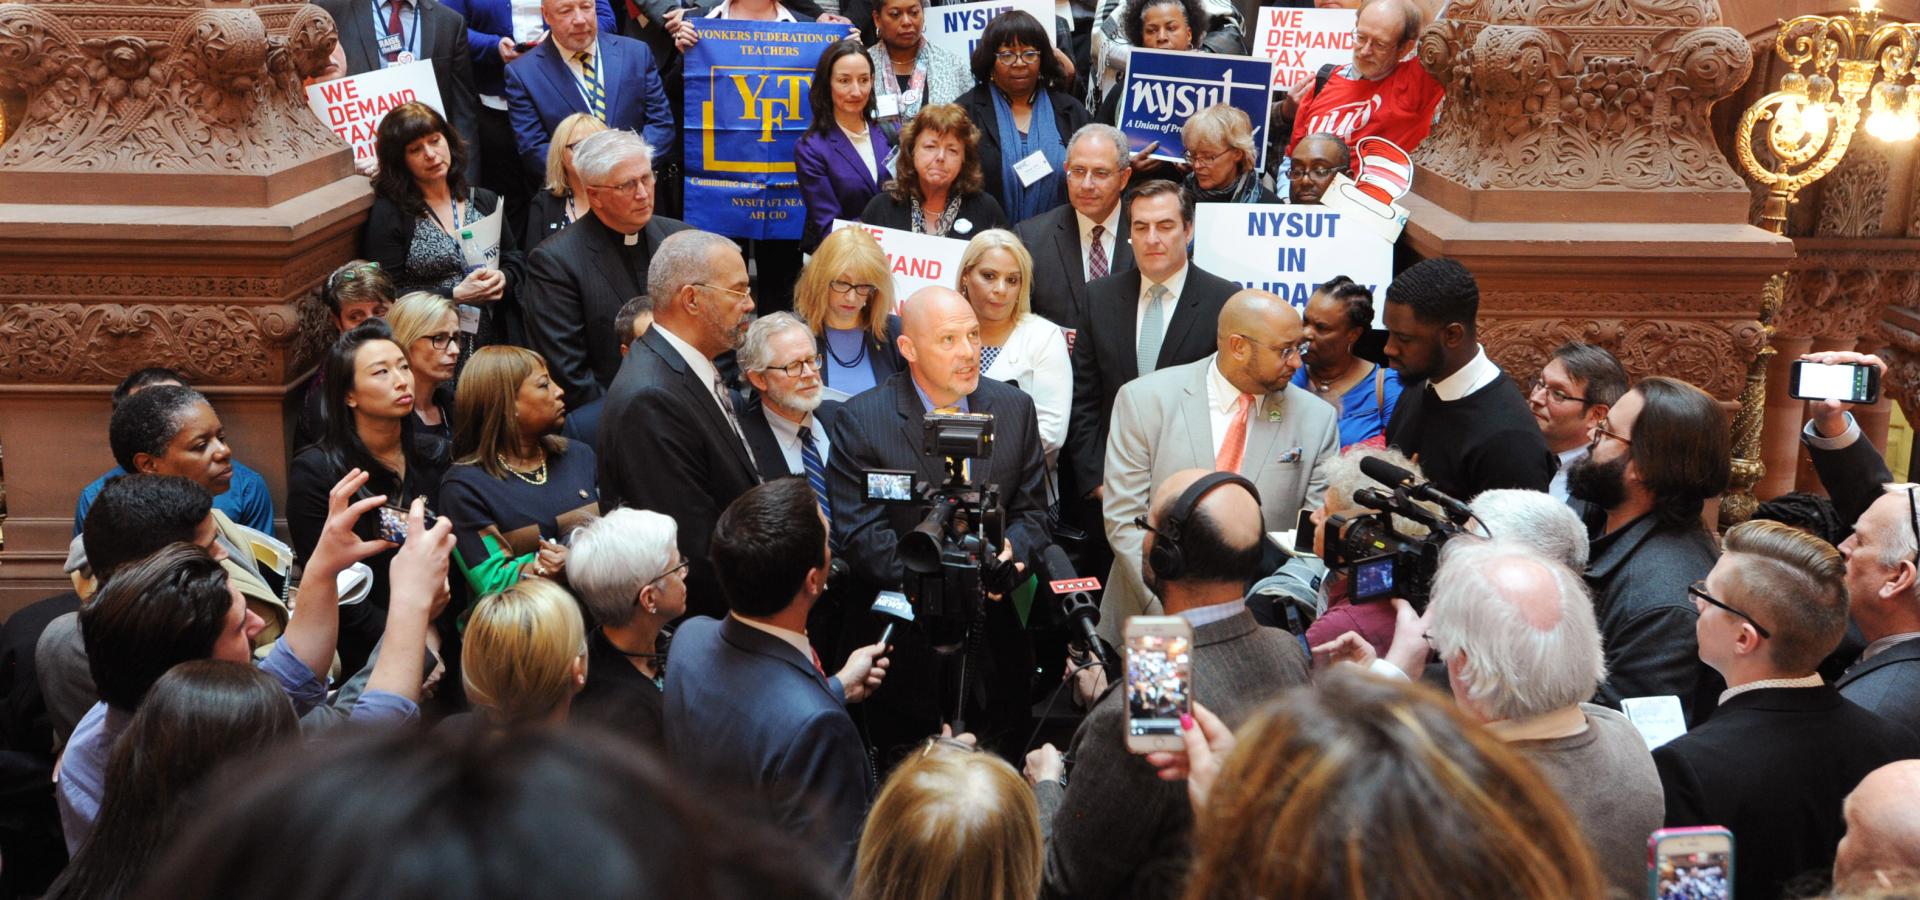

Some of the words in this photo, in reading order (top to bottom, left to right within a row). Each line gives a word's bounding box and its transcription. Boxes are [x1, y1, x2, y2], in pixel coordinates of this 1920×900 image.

[1271, 10, 1303, 28] WE
[698, 29, 750, 41] YONKERS
[754, 31, 823, 43] FEDERATION
[1267, 29, 1353, 50] DEMAND
[740, 45, 800, 56] TEACHERS
[1265, 49, 1306, 67] TAX
[320, 80, 359, 104] WE
[328, 89, 417, 126] DEMAND
[334, 120, 378, 144] TAX
[1135, 121, 1159, 131] Union
[1161, 124, 1172, 135] of
[732, 198, 765, 208] NYSUT
[785, 198, 803, 207] NEA
[769, 211, 787, 220] CIO
[1248, 212, 1340, 238] NYSUT
[886, 254, 942, 280] AND
[1278, 247, 1306, 272] IN
